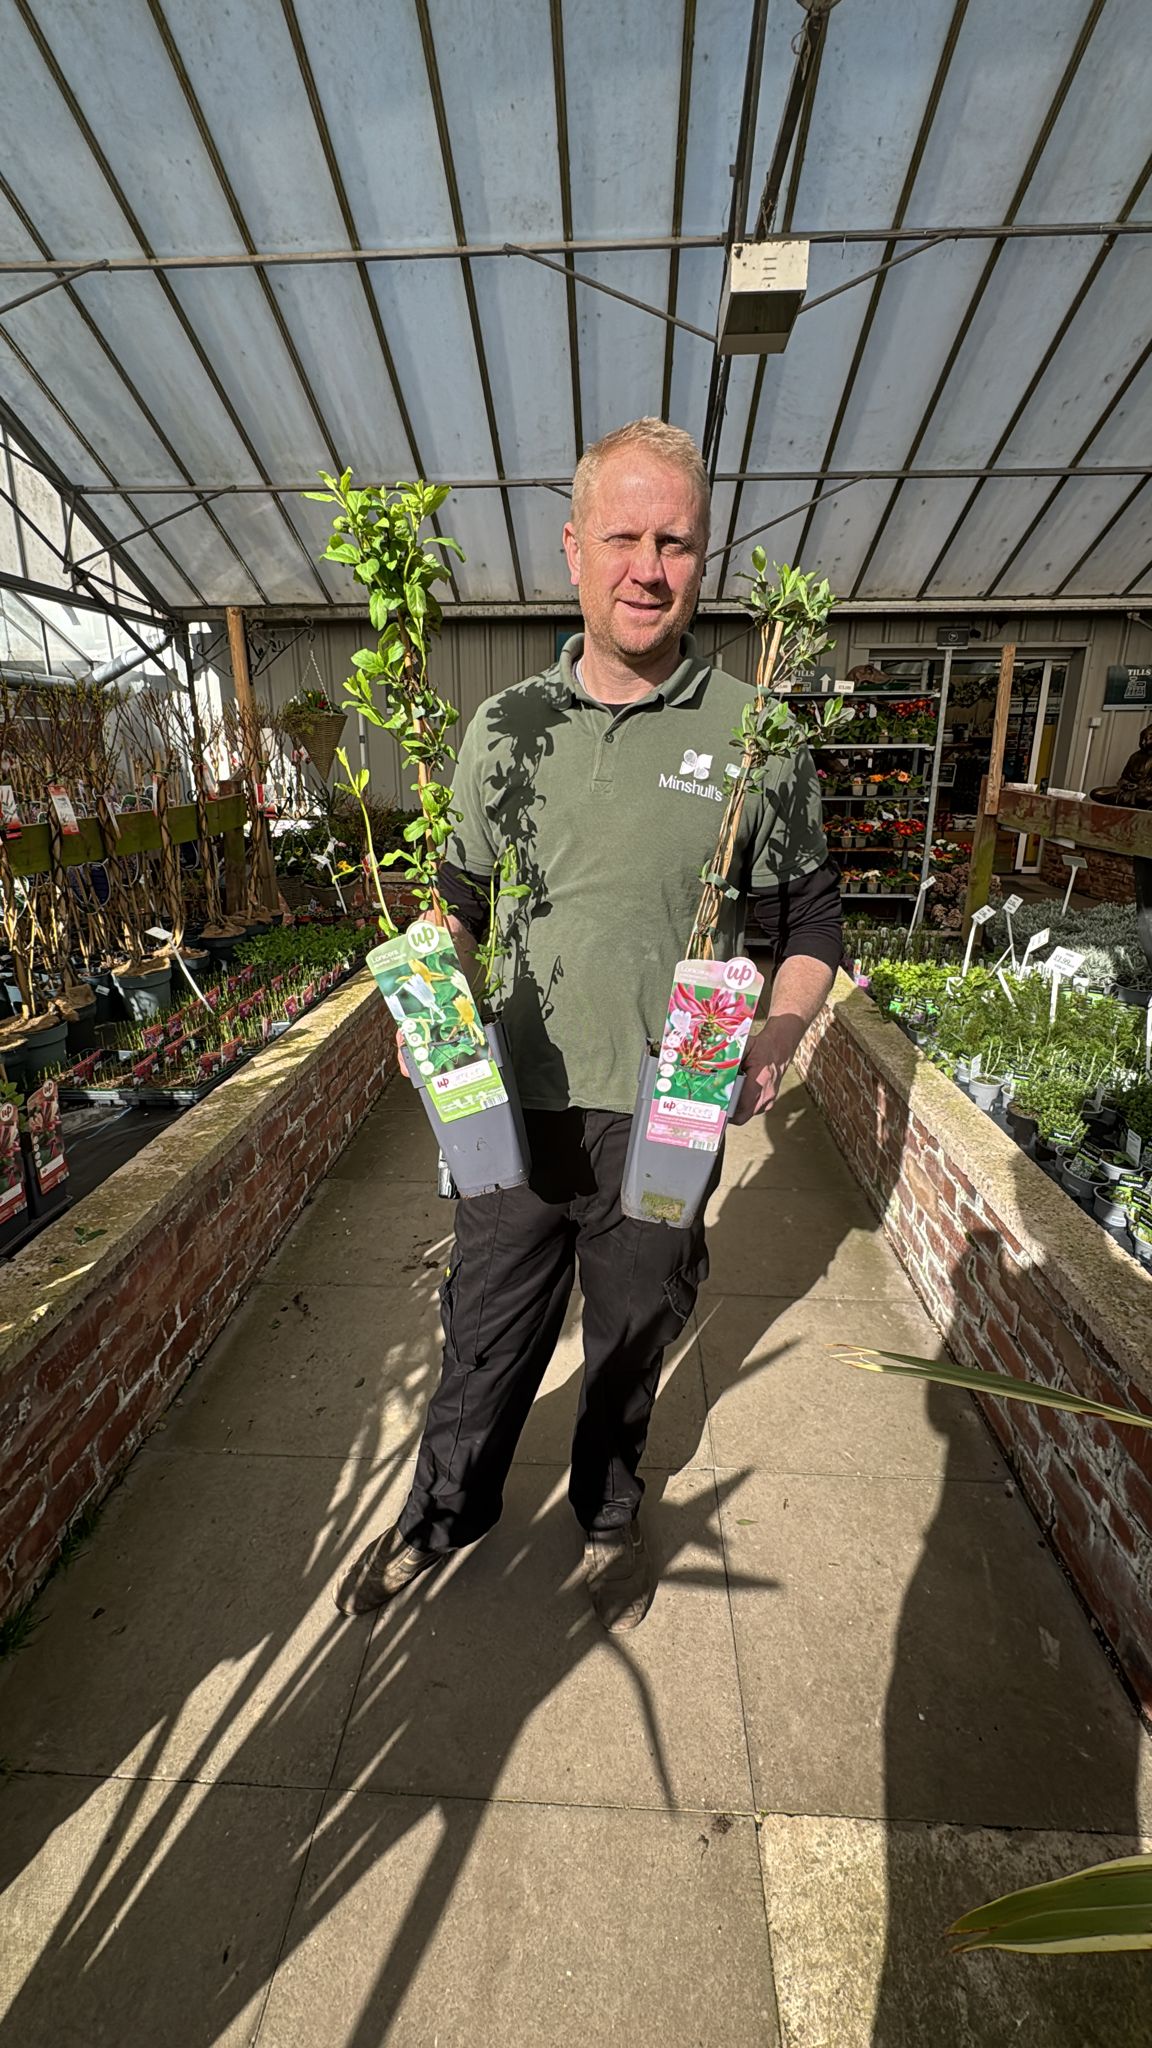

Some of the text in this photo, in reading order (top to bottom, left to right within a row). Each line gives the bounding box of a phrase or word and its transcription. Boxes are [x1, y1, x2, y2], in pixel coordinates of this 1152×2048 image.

[1128, 668, 1151, 676] TILLS
[658, 773, 723, 802] Minshull's
[411, 926, 435, 947] up
[727, 964, 752, 986] up
[437, 1077, 450, 1088] up
[663, 1100, 676, 1112] up
